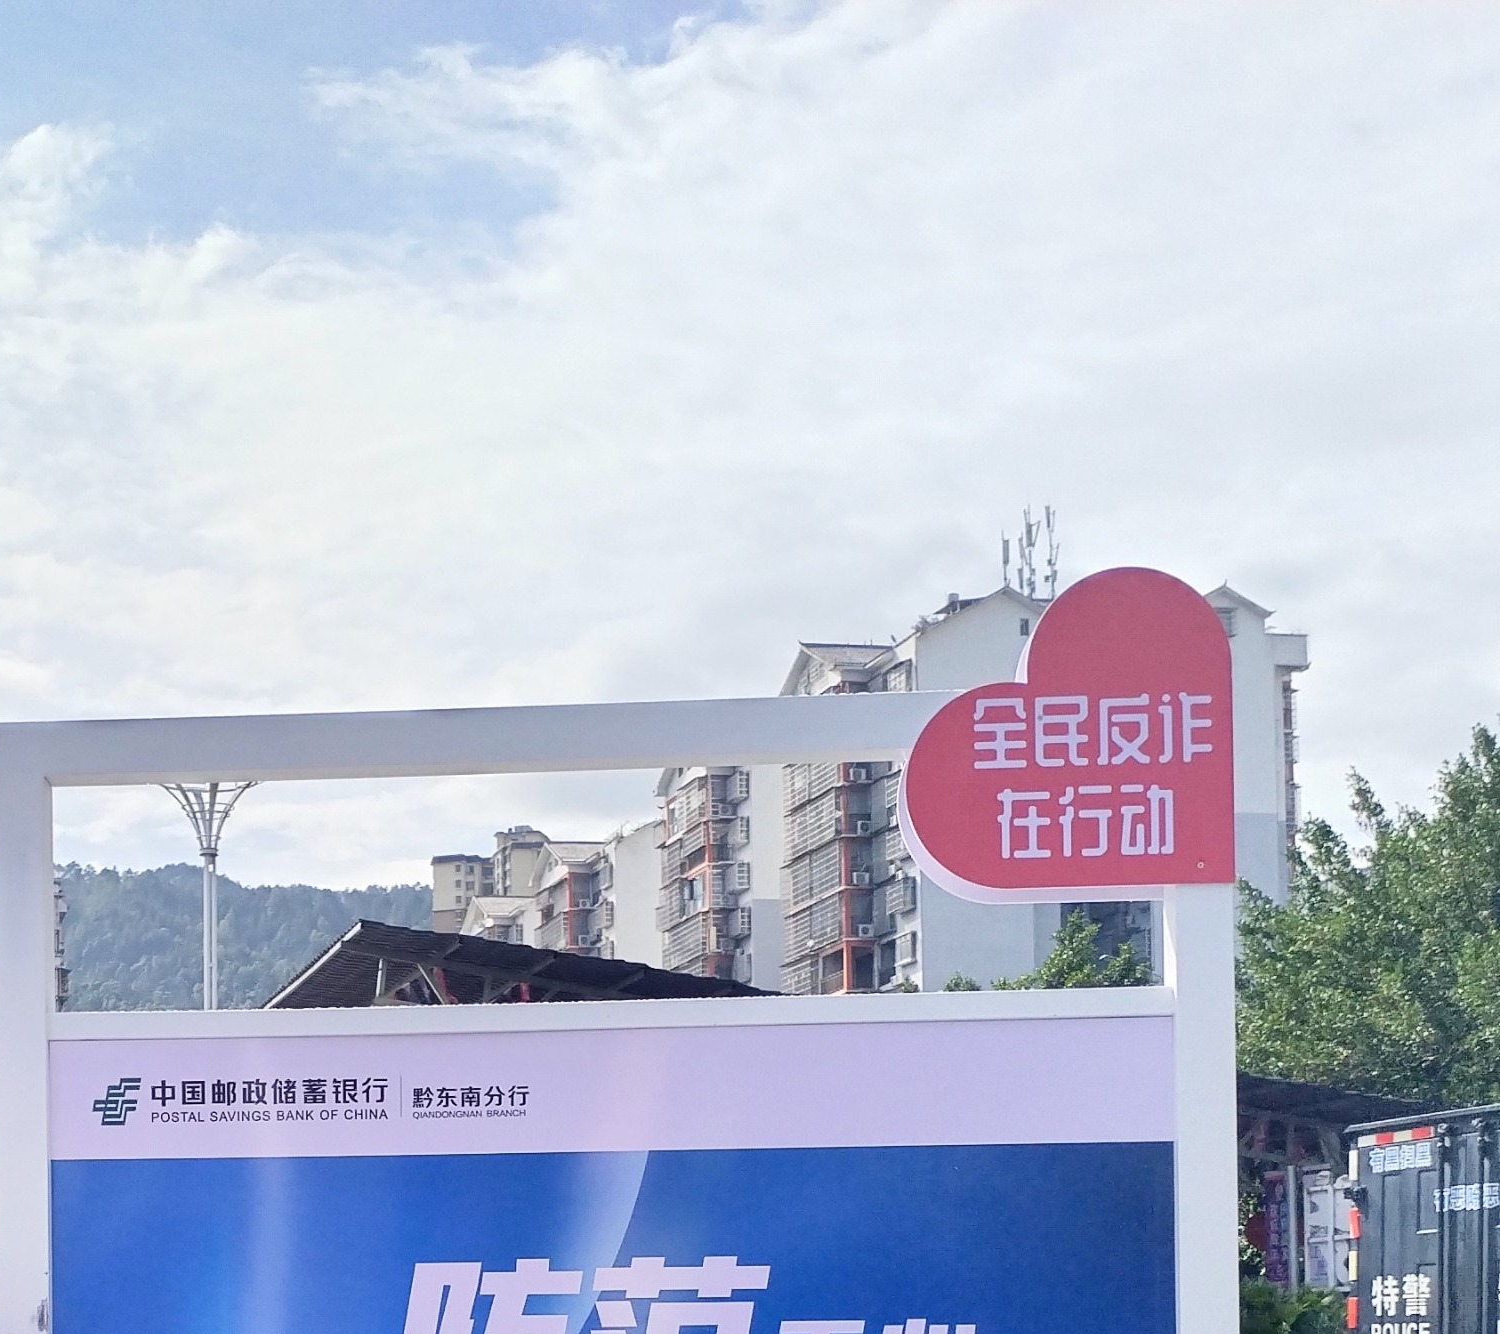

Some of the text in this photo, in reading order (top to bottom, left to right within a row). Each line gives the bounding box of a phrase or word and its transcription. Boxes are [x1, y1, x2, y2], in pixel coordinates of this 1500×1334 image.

[973, 692, 1213, 770] 全民反诈
[997, 784, 1175, 859] 在行动
[150, 1076, 389, 1107] 中国邮政储蓄银行
[412, 1085, 530, 1109] 黔东南分行
[150, 1108, 389, 1123] POSTAL SAVINGS BANK OF CHINA
[412, 1109, 527, 1119] QIANDONGNAN BRANCH
[1371, 1273, 1431, 1317] 特警
